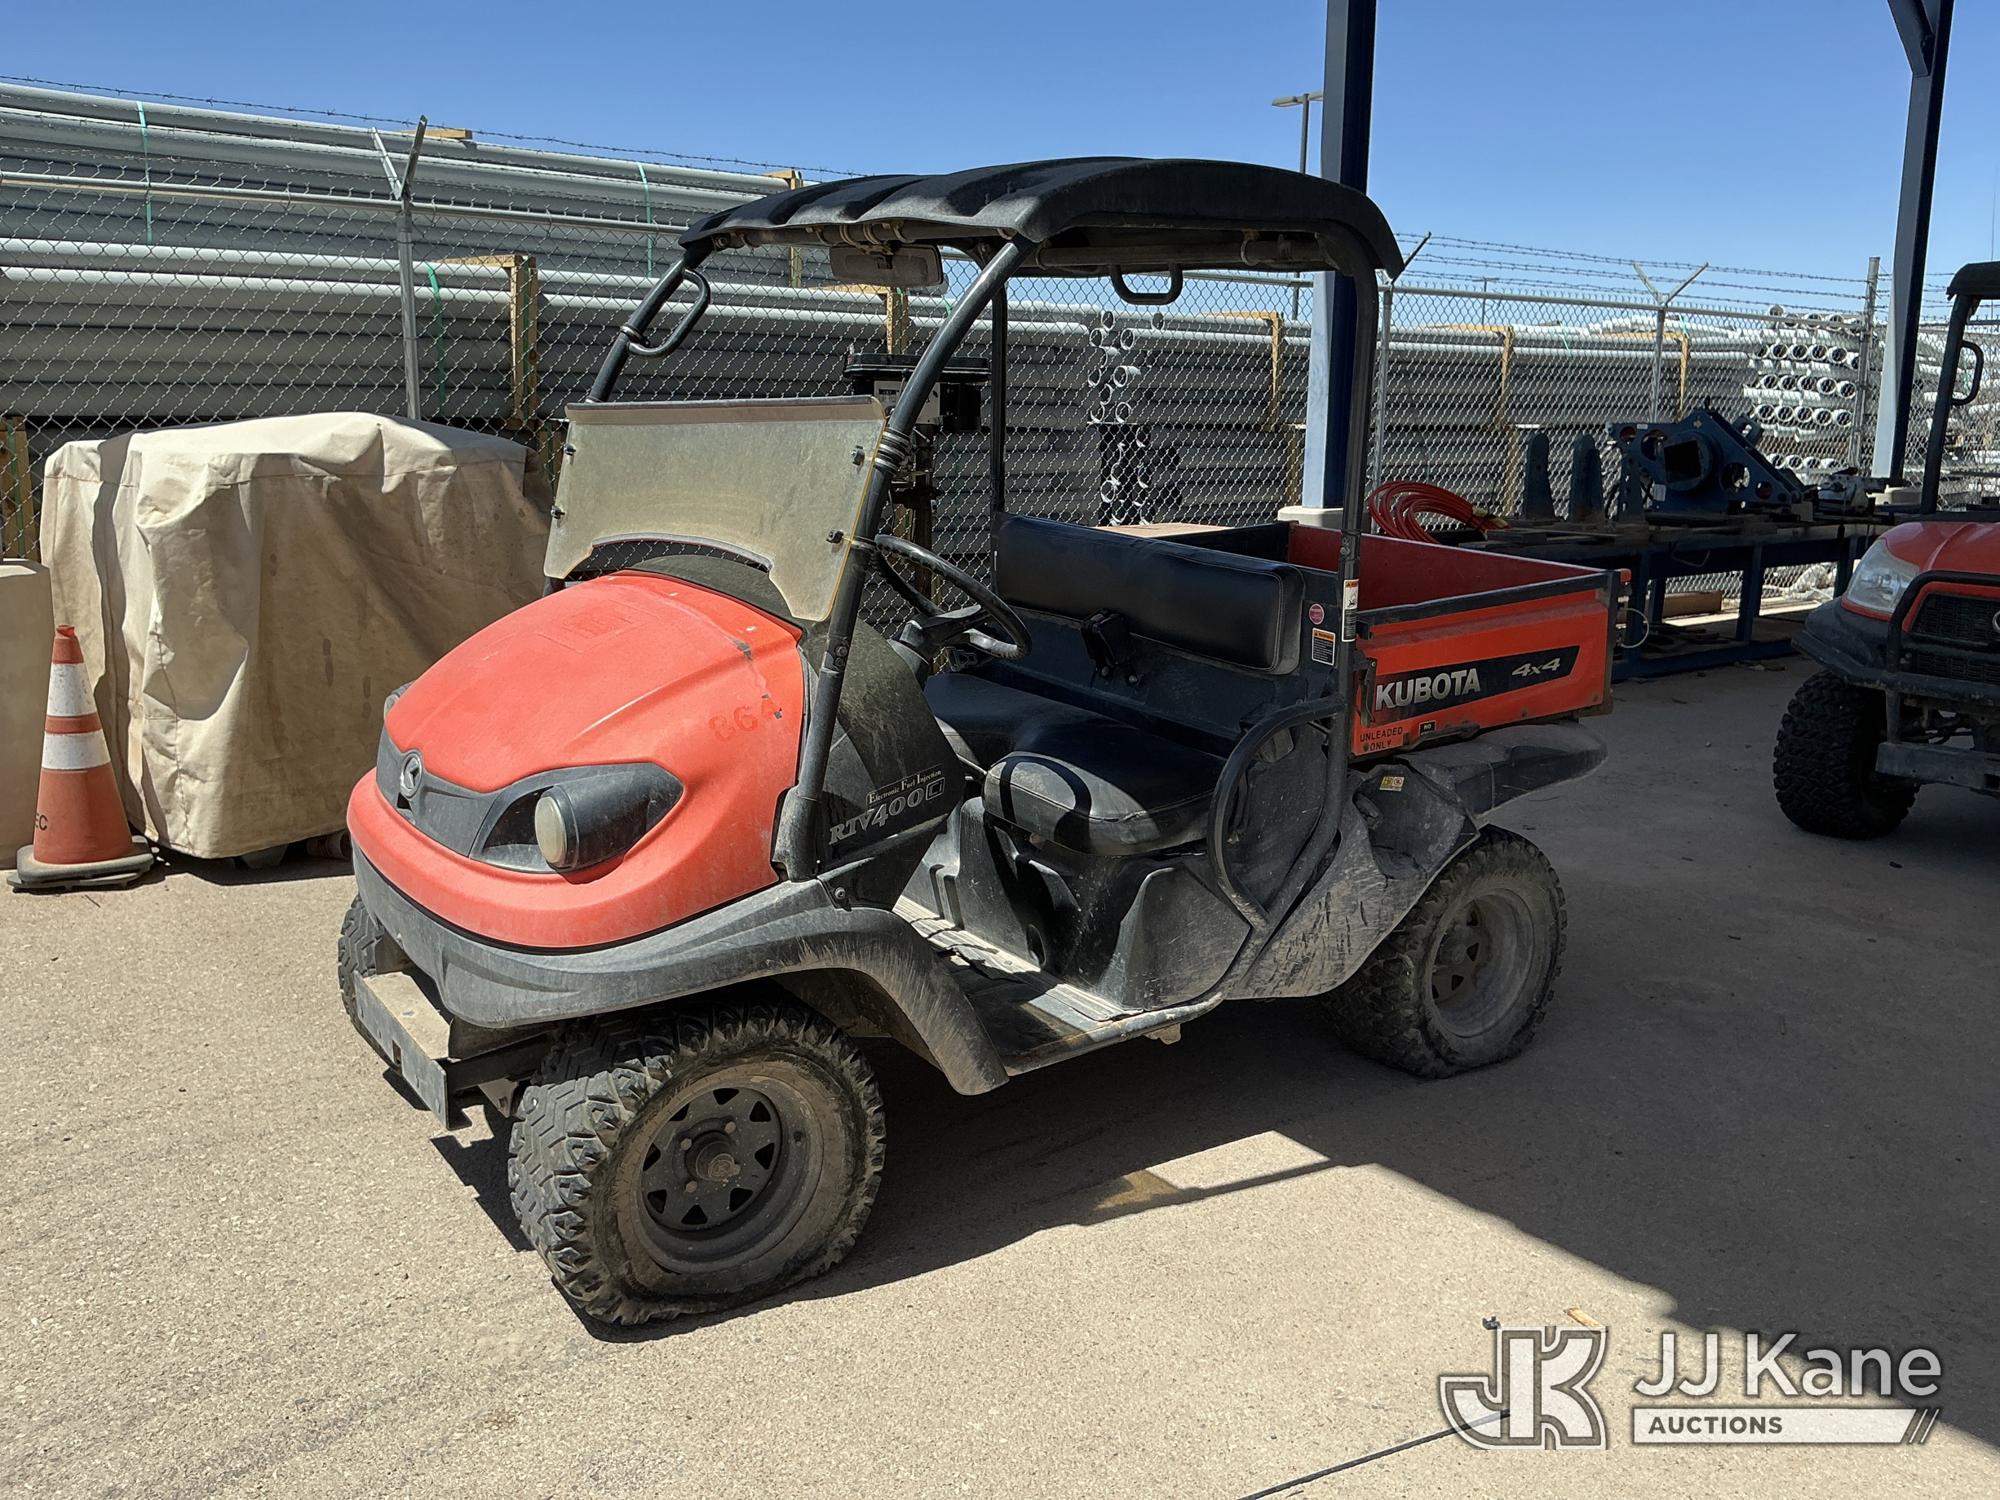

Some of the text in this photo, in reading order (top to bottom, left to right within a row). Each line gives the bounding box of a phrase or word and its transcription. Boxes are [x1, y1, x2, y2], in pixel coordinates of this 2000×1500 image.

[1375, 657, 1561, 710] KUBOTA 4x4
[1360, 726, 1403, 742] UNLEADED
[1370, 740, 1392, 751] ONLY
[868, 786, 900, 804] Electronic
[901, 778, 916, 791] Fuel
